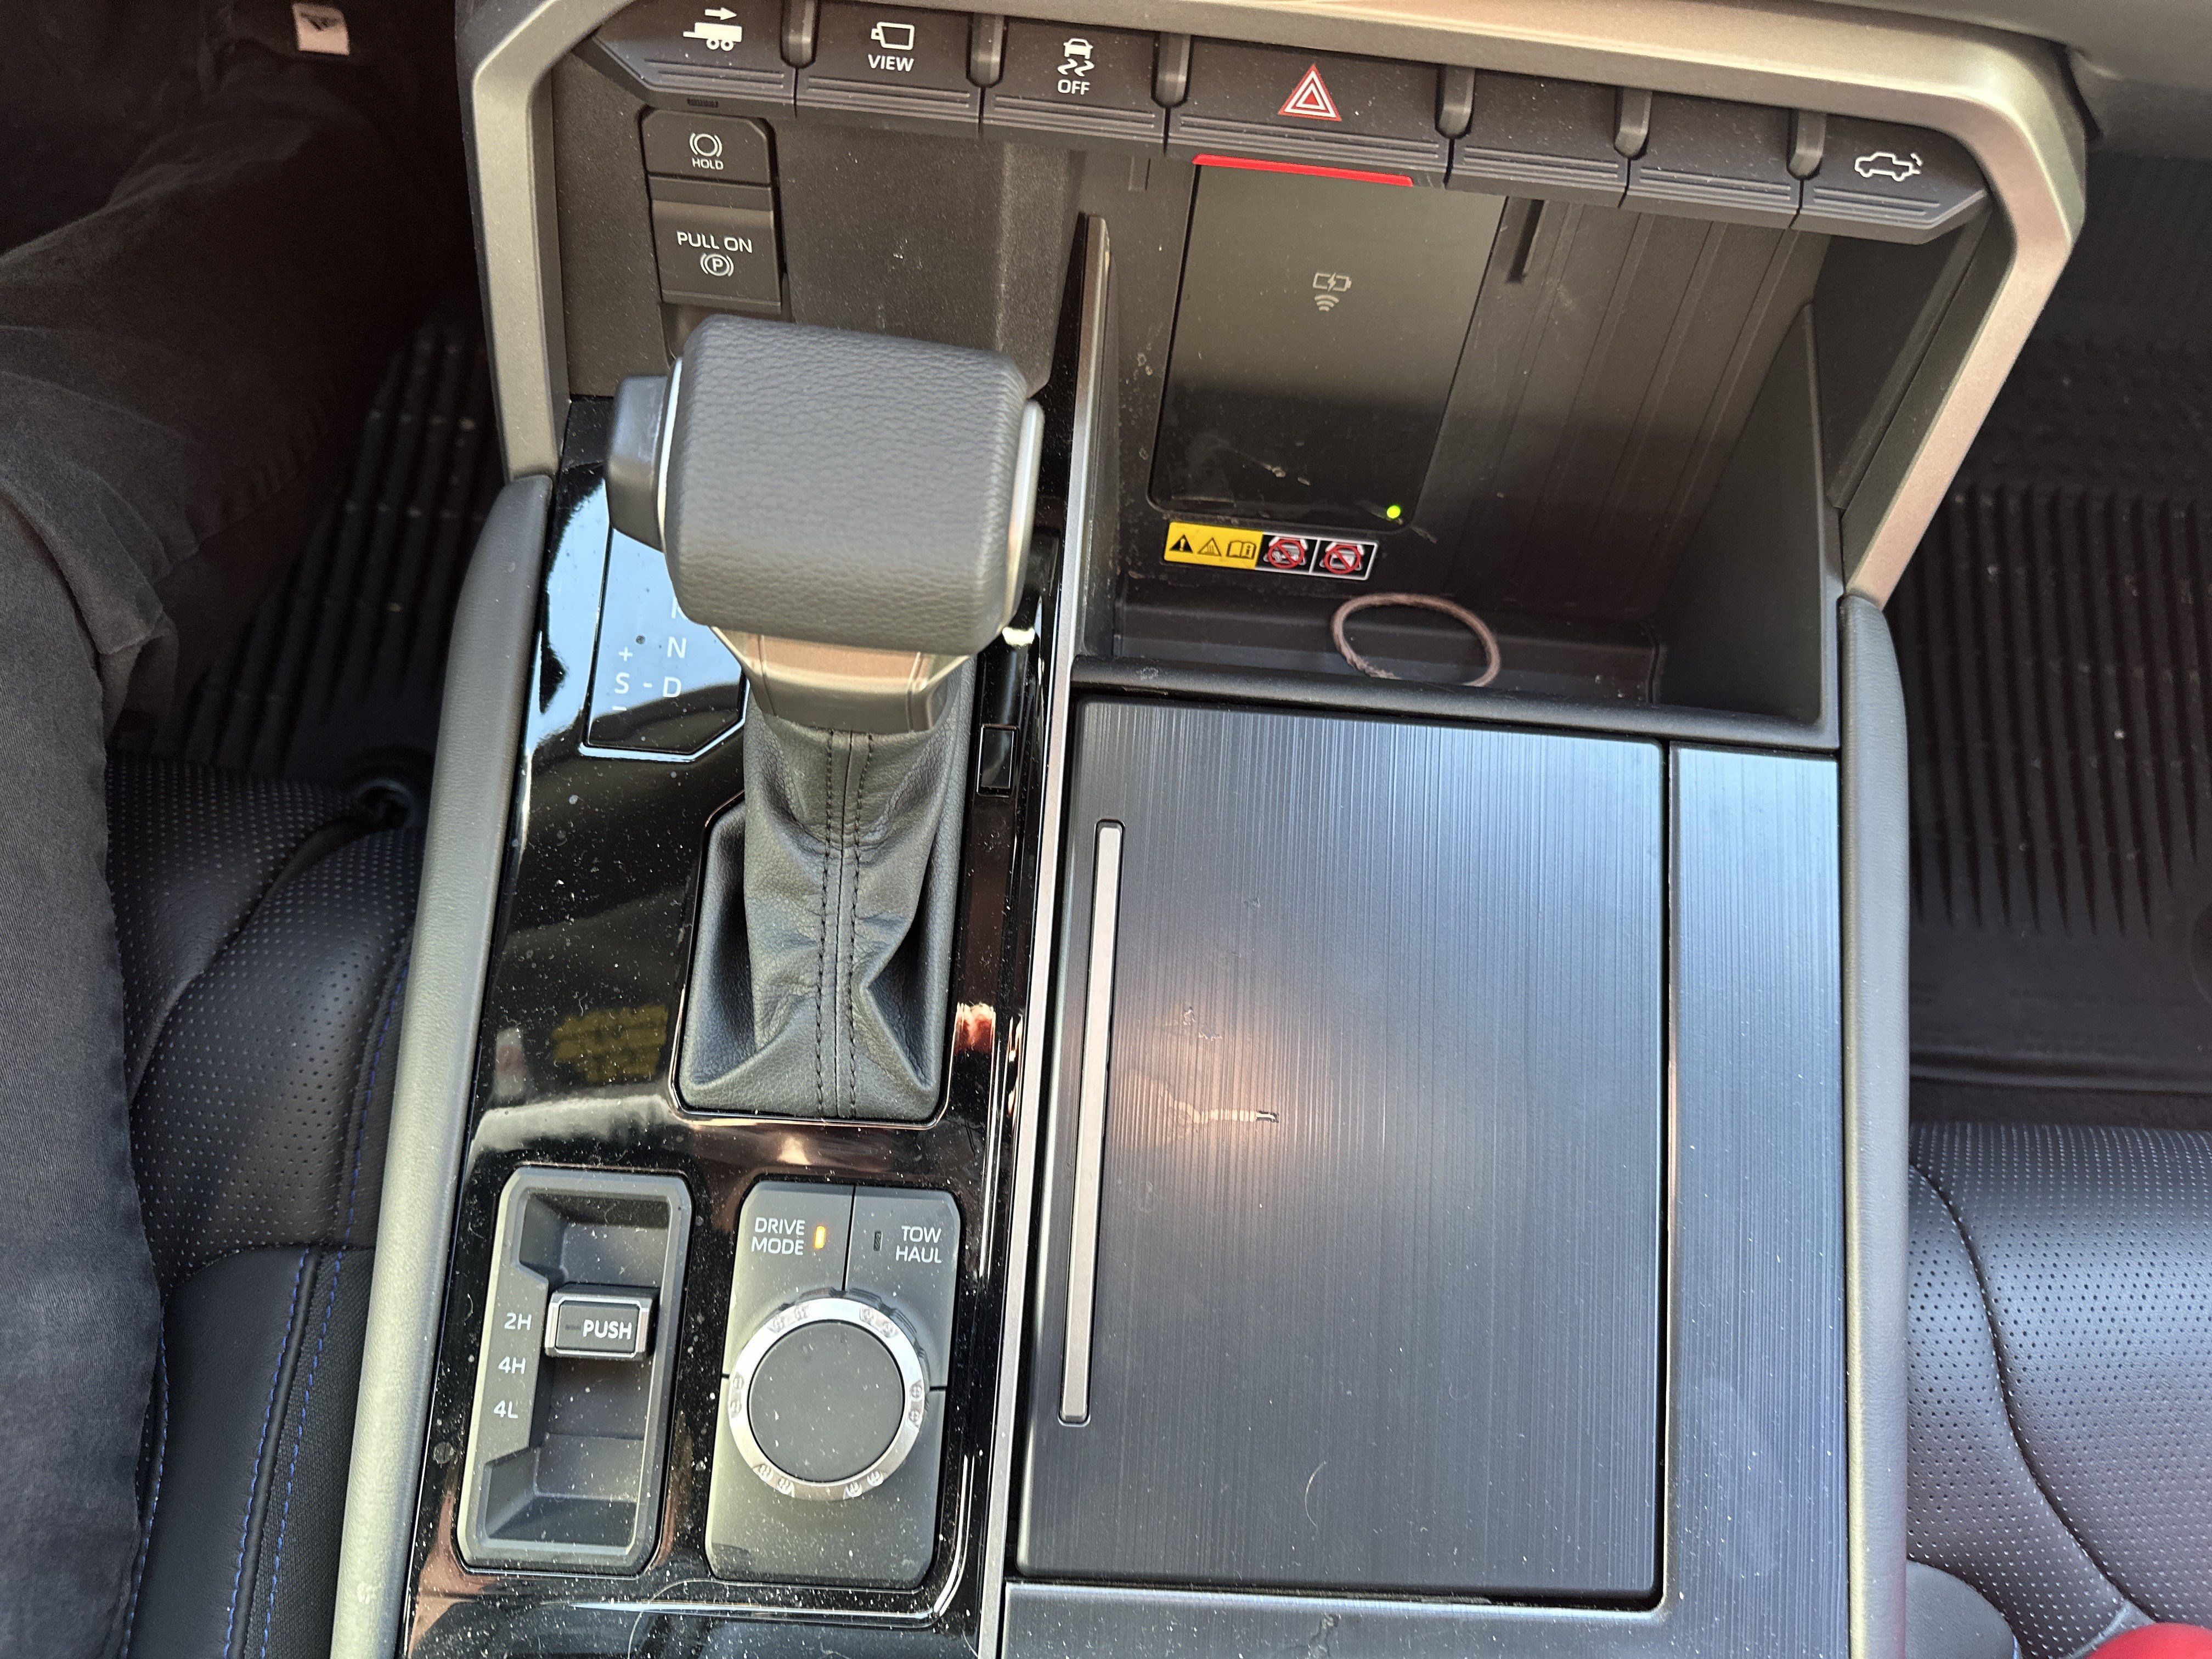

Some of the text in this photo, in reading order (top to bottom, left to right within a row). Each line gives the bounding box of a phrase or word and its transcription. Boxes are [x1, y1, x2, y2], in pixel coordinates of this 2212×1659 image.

[868, 55, 914, 72] VIEW
[1058, 80, 1090, 95] OFF
[692, 158, 724, 170] HOLD
[677, 232, 752, 253] PULL ON
[667, 636, 687, 658] N
[614, 673, 630, 694] S
[663, 677, 682, 698] D
[754, 1217, 806, 1236] DRIVE
[901, 1226, 942, 1244] TOW
[751, 1237, 804, 1256] MODE
[895, 1245, 942, 1264] HAUL
[504, 1313, 532, 1331] 2H
[583, 1319, 633, 1340] PUSH
[498, 1356, 526, 1374] 4H
[493, 1401, 519, 1419] 4L
